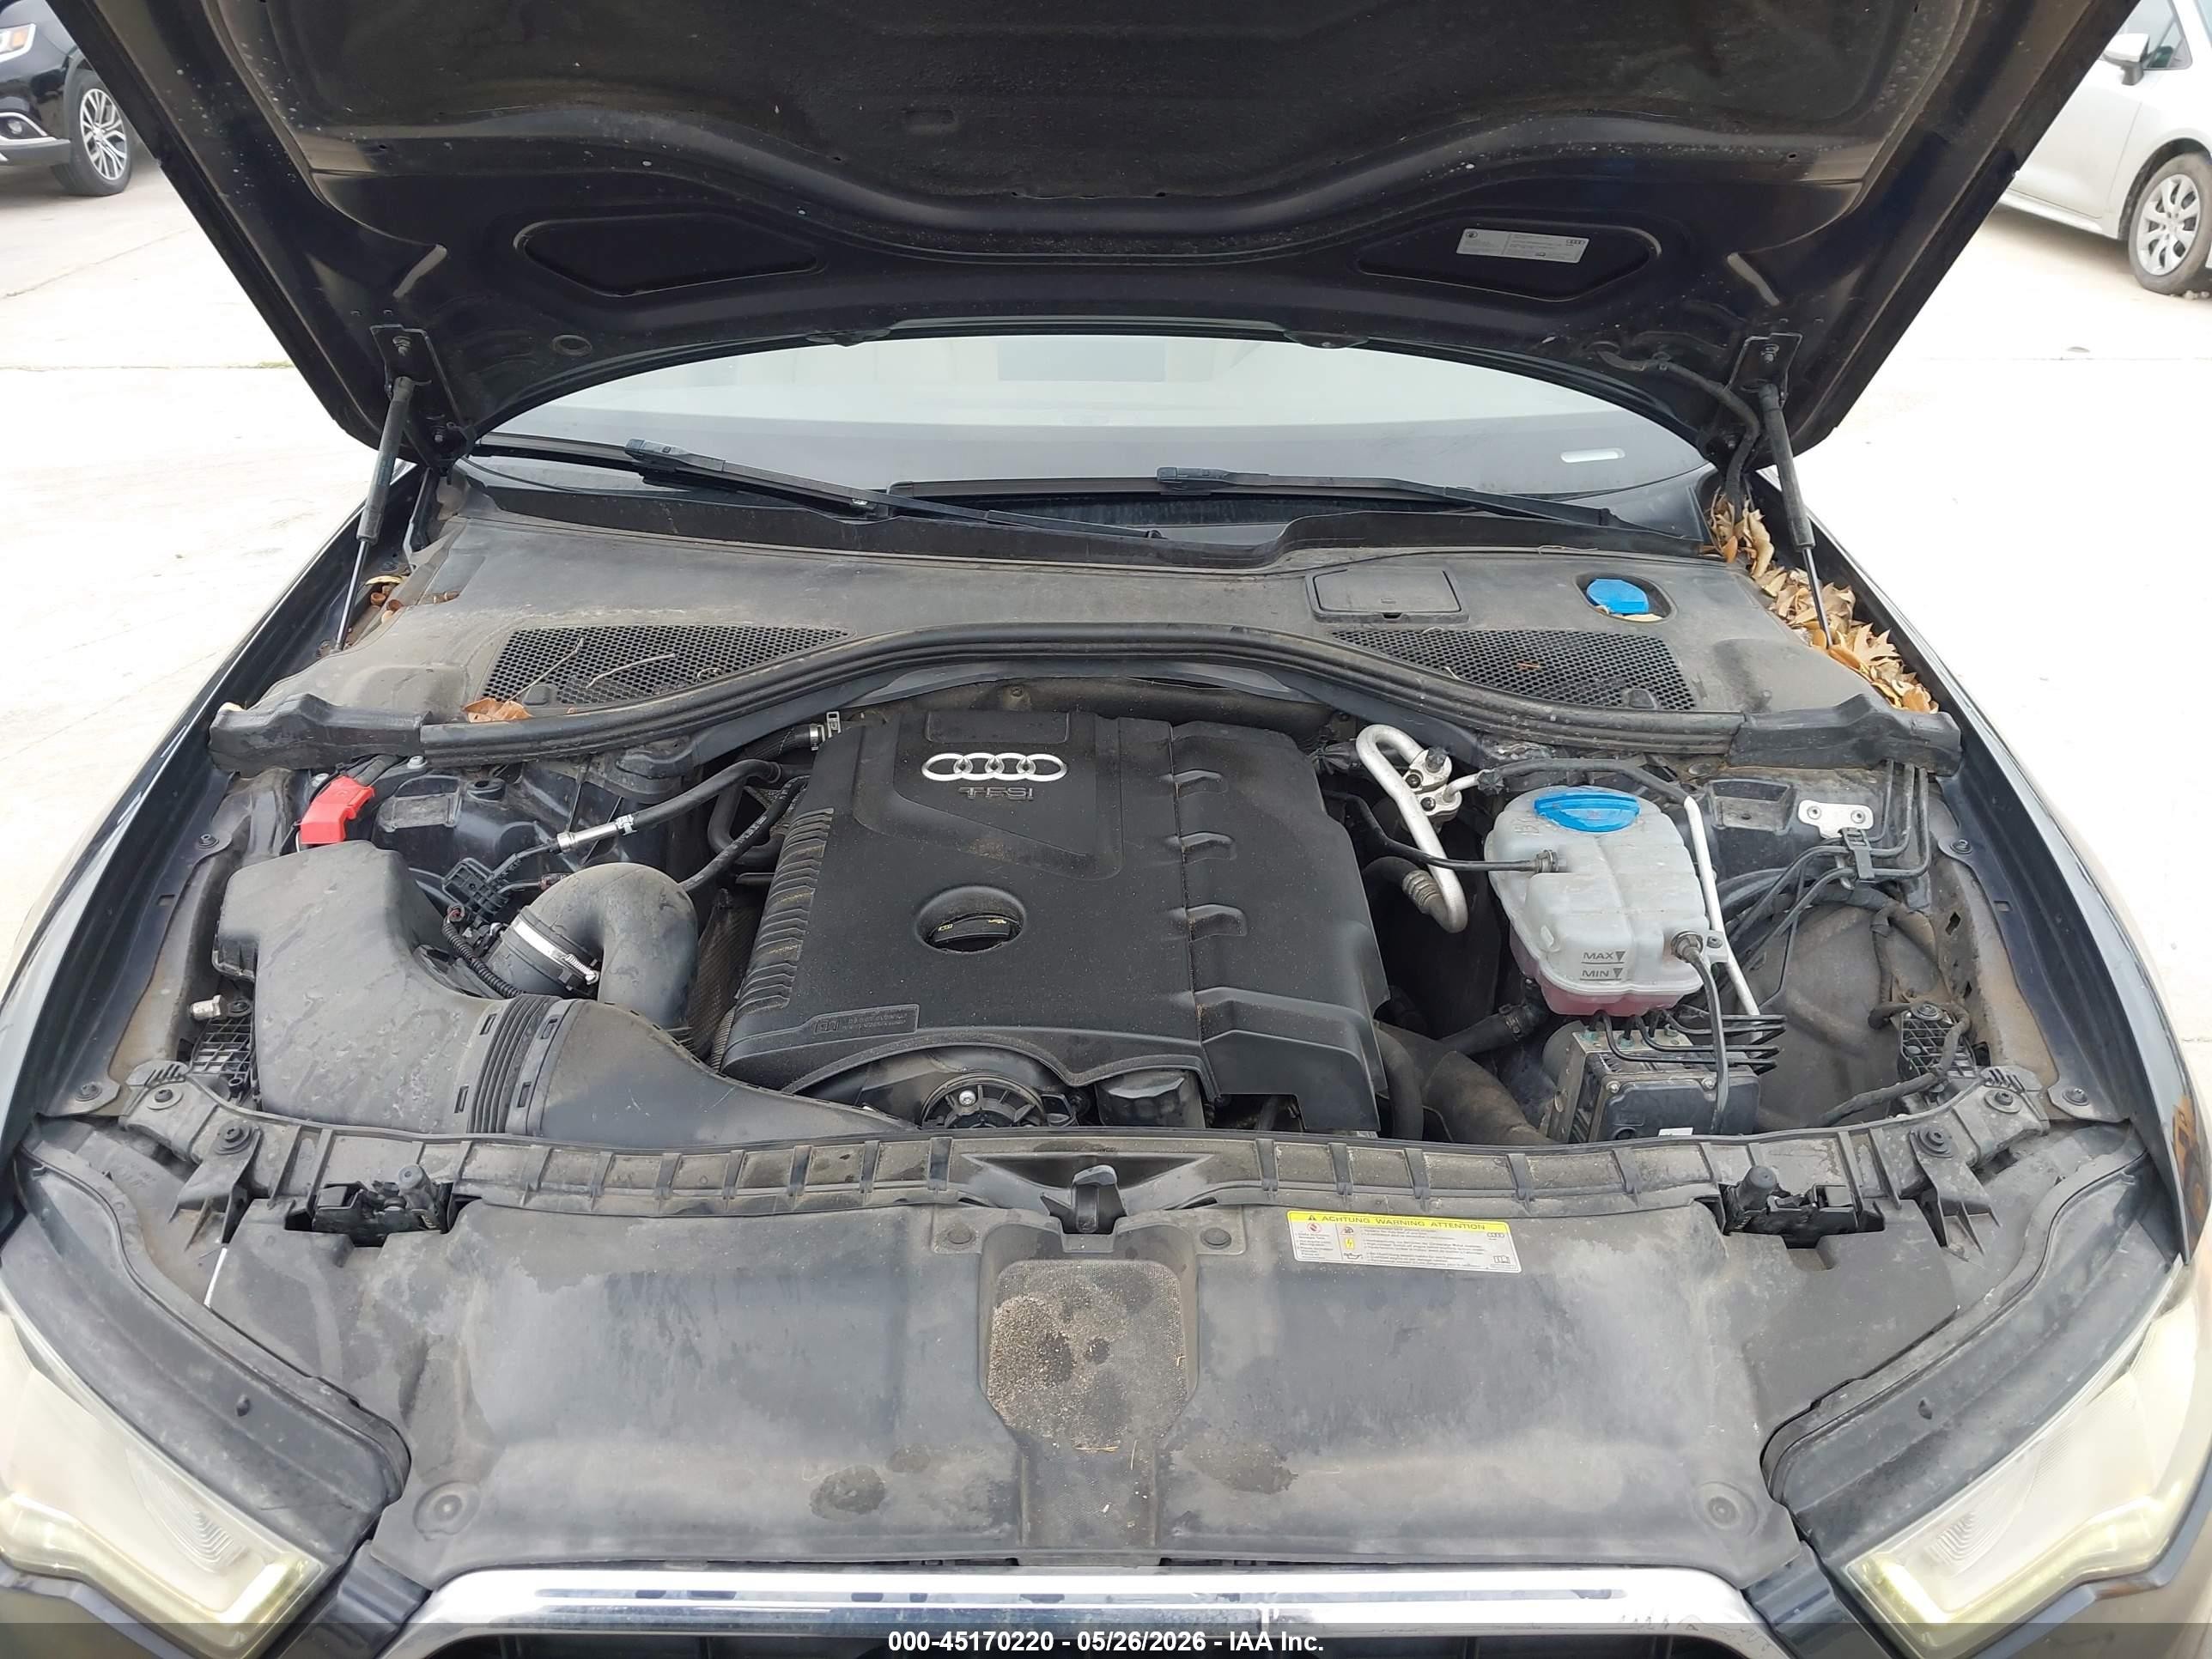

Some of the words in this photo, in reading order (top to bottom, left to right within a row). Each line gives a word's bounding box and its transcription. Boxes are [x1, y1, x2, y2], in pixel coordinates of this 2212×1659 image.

[958, 786, 1035, 801] TFSI
[1583, 951, 1614, 960] MAX
[1582, 969, 1610, 978] MIN
[1321, 1215, 1370, 1224] ACHTUNG
[1376, 1218, 1425, 1227] WARNING
[1430, 1221, 1486, 1231] ATTENTION
